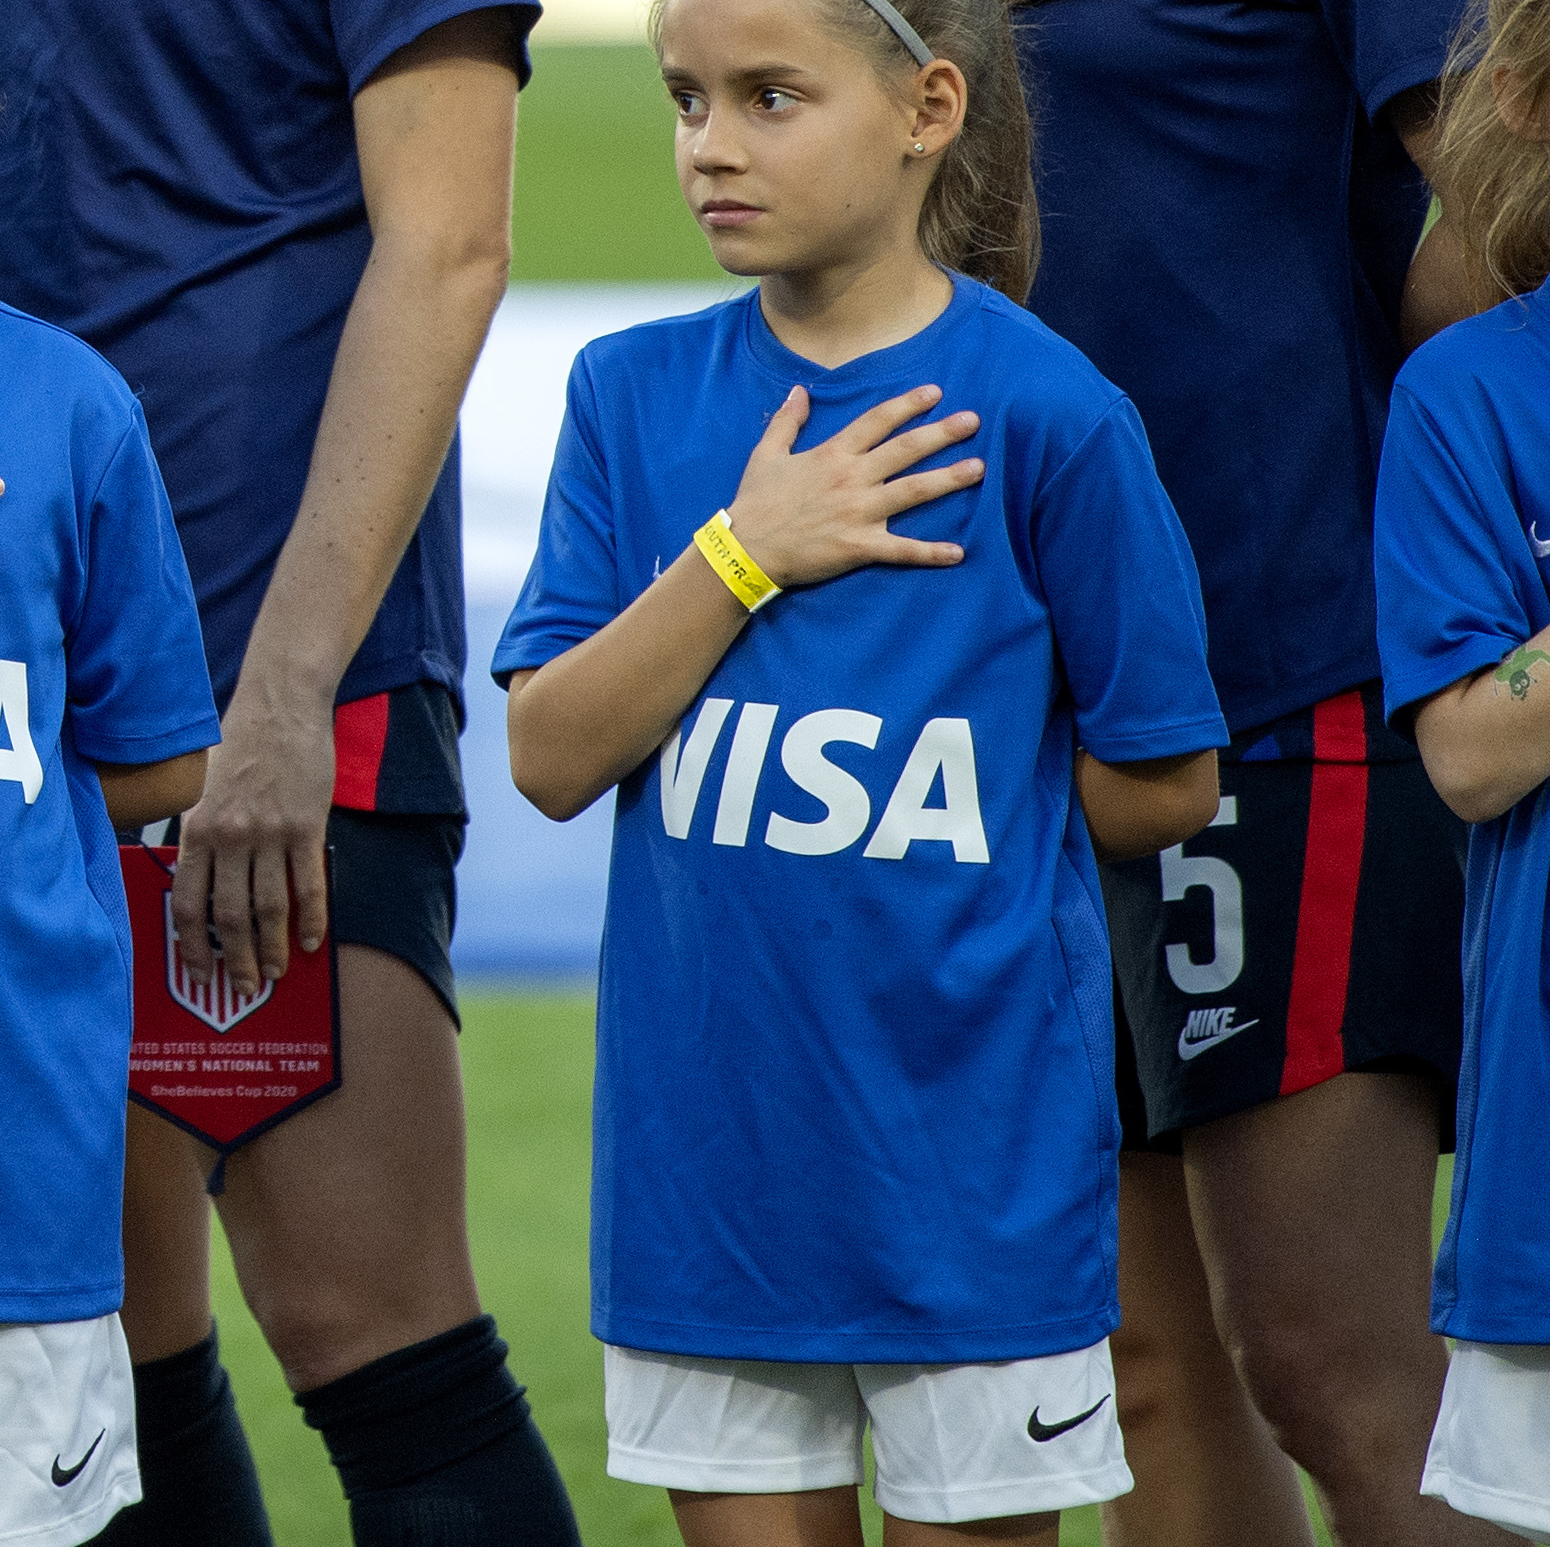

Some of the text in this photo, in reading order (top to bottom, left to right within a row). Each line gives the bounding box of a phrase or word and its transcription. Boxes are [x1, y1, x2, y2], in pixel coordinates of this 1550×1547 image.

[660, 698, 990, 863] VISA
[1159, 795, 1244, 994] 5
[1186, 1007, 1237, 1038] NIKE
[130, 1042, 328, 1055] ITED STATES SOCCER FEDERATION
[130, 1060, 320, 1072] WOMEN'S NATIONAL TEAM
[151, 1085, 298, 1099] SheBelieves Cup 2020
